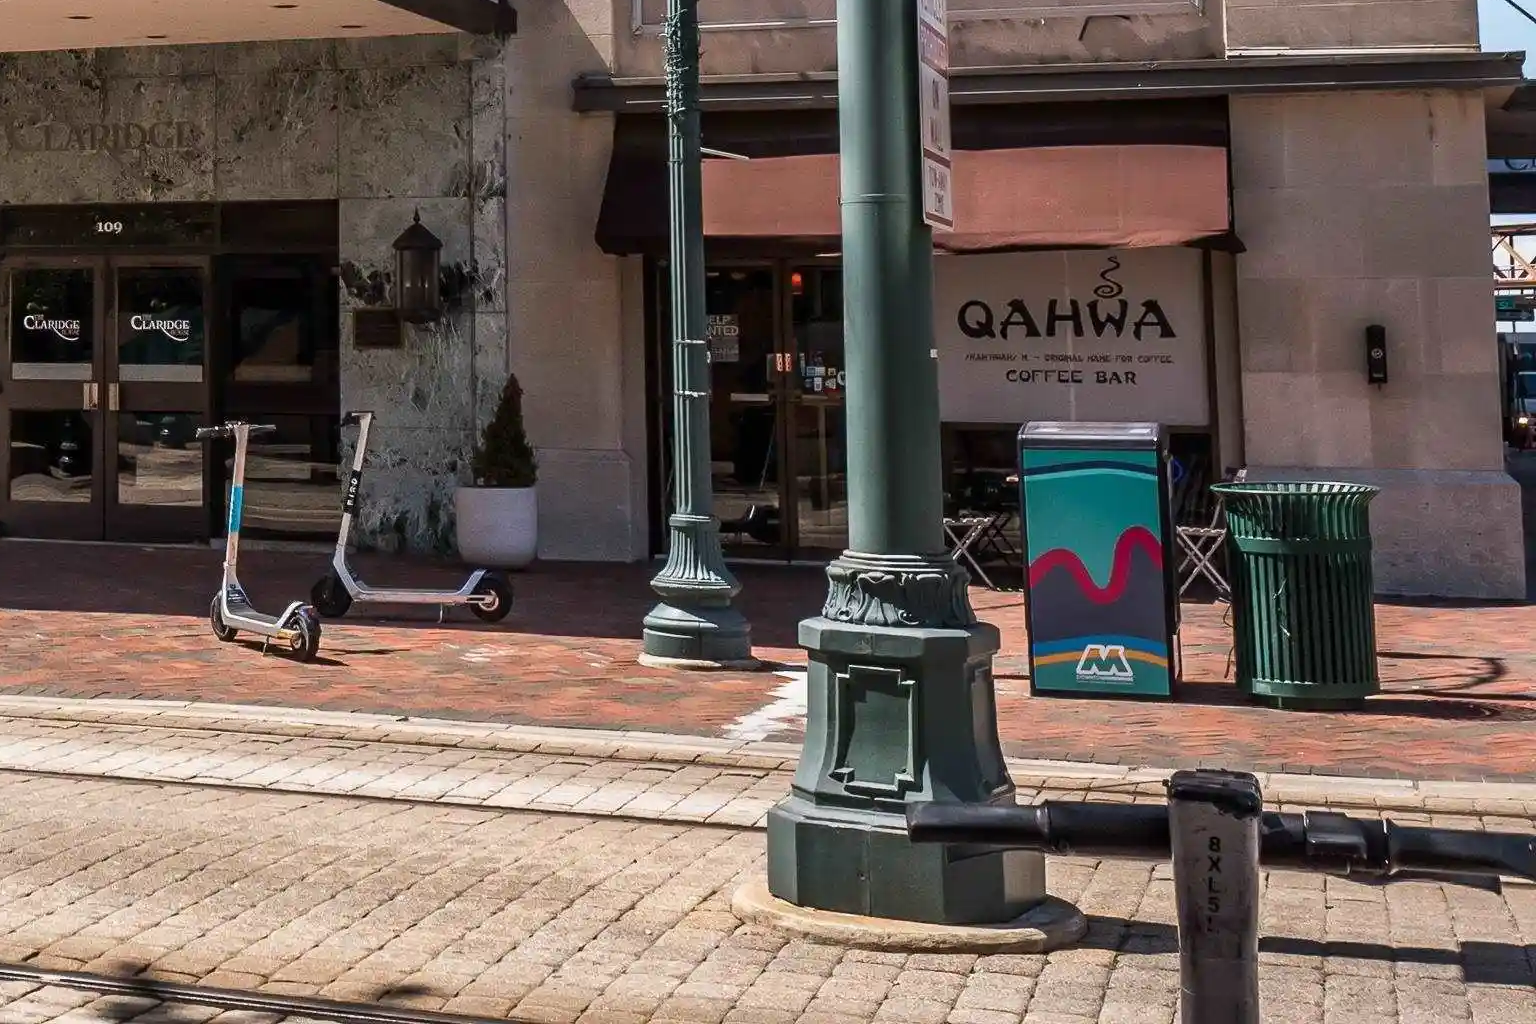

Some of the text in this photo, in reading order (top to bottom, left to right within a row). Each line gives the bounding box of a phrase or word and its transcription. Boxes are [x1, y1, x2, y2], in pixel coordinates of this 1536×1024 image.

[96, 221, 123, 234] 109
[24, 315, 80, 336] CLARIDGE
[131, 315, 190, 336] CLARIDGE
[709, 315, 731, 325] ELP
[957, 298, 1177, 341] QAHWA
[706, 326, 739, 336] NTED
[1114, 354, 1133, 364] FOR
[1006, 369, 1138, 385] COFFEE BAR
